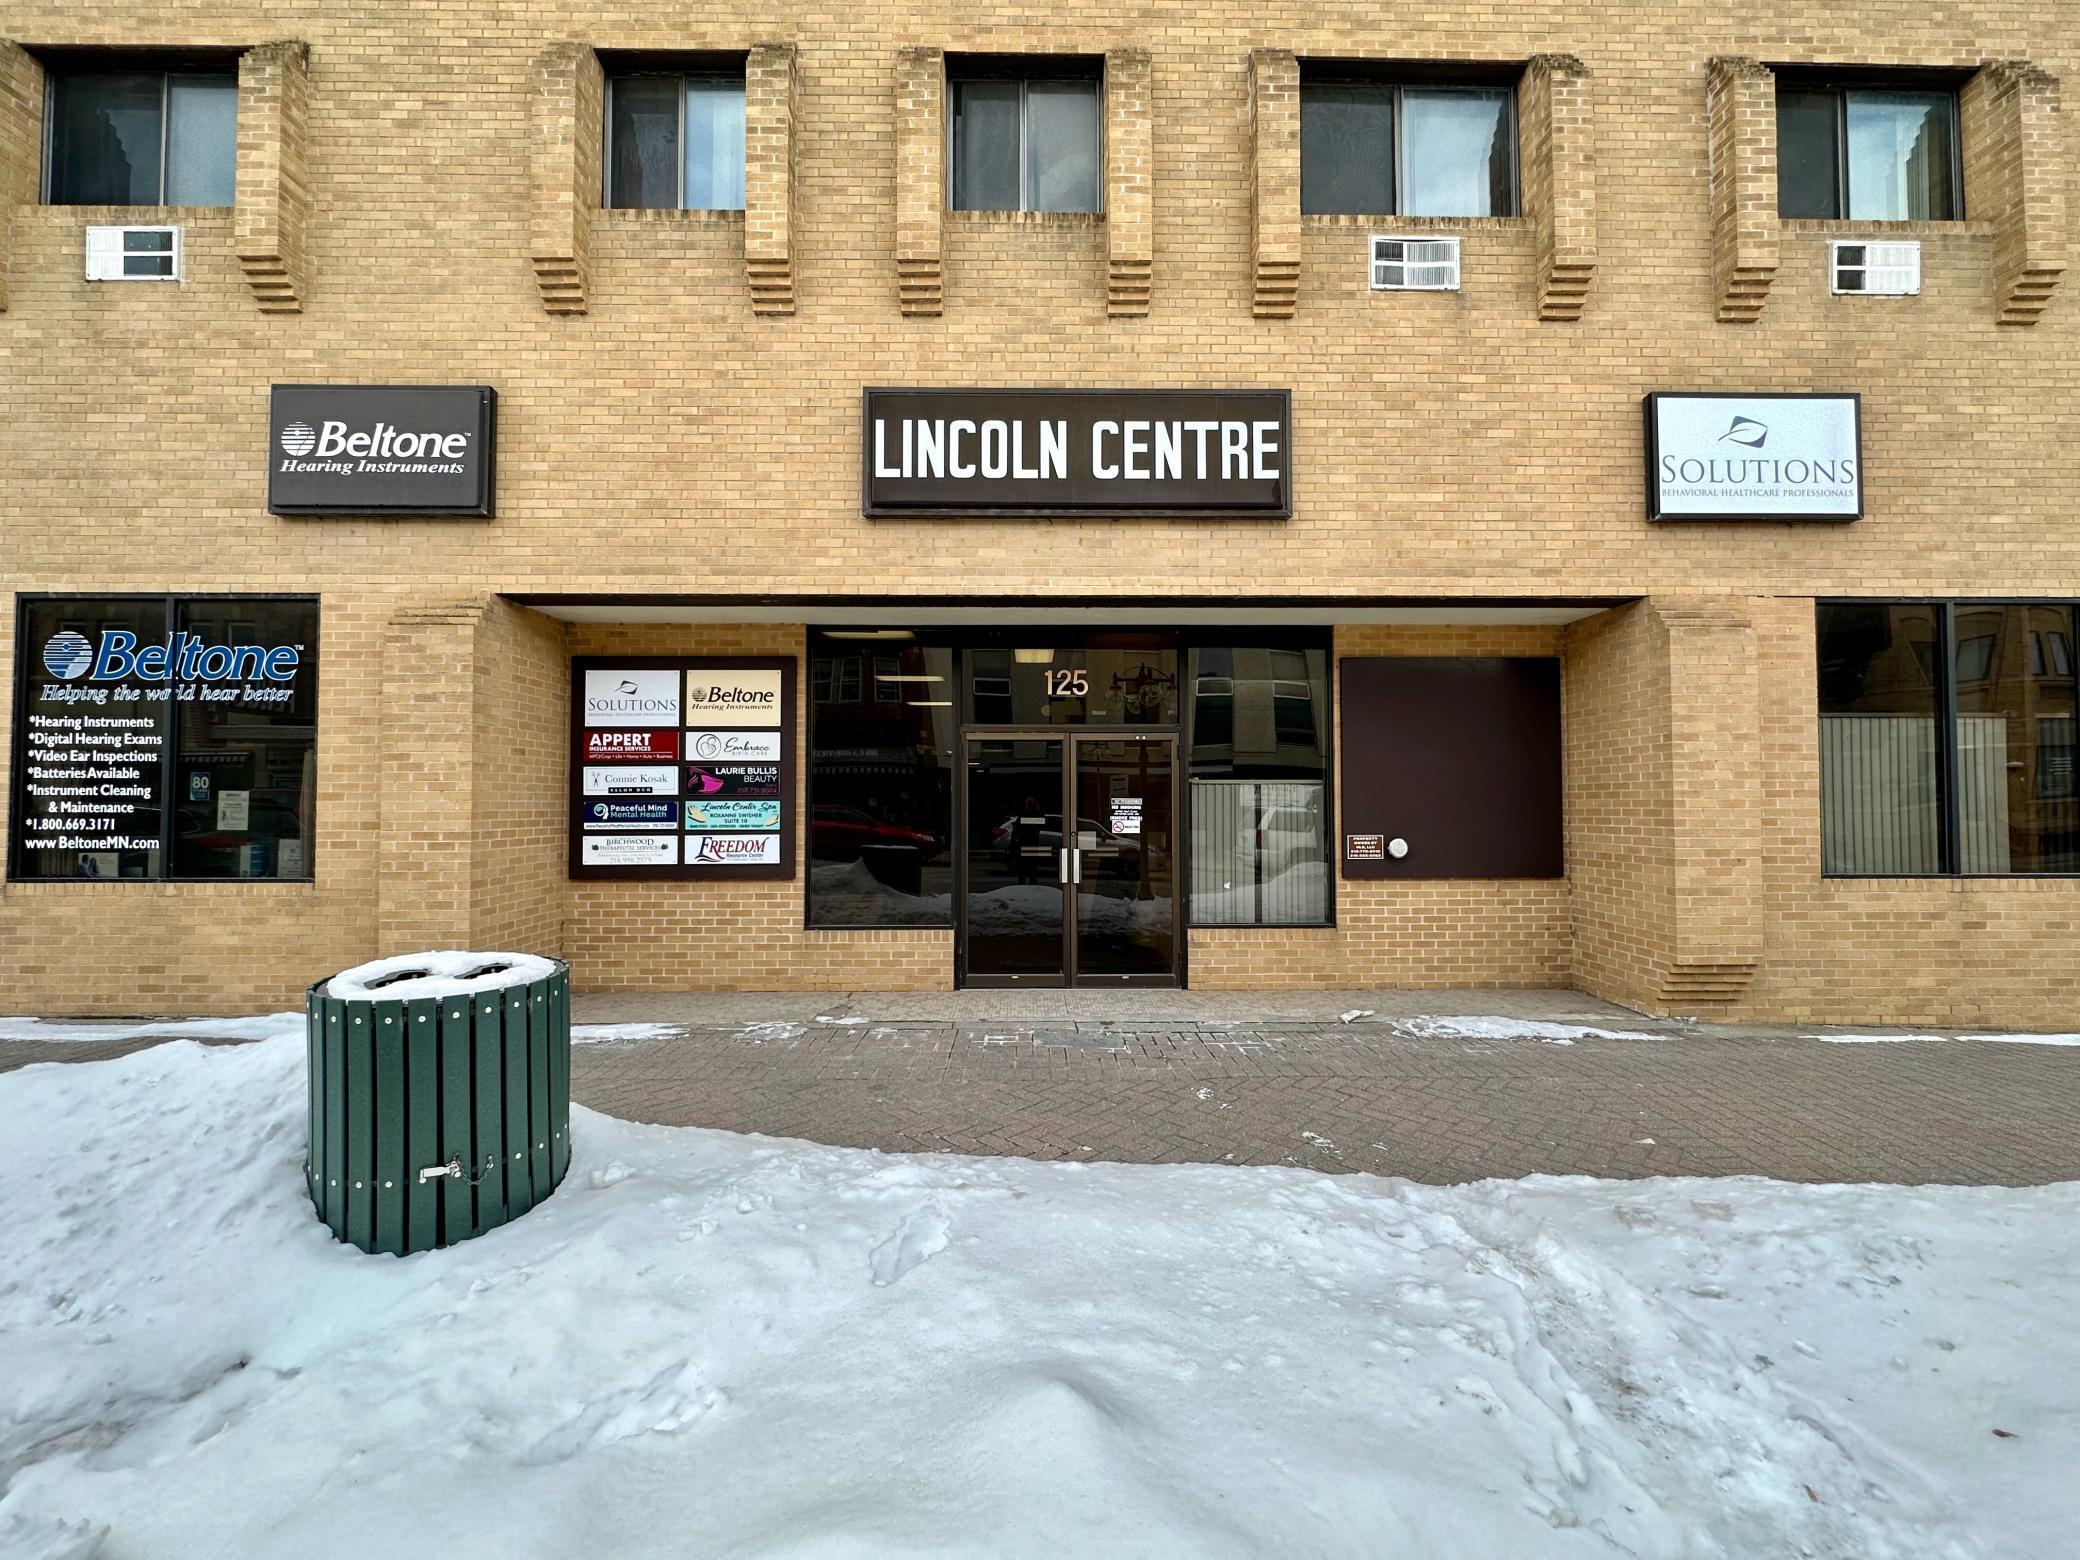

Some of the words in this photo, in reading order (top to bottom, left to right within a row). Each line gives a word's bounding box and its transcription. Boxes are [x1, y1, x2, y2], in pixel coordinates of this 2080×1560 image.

[874, 418, 1068, 479] LINCOLN
[1091, 420, 1280, 480] CENTRE
[280, 459, 354, 475] Hearing
[356, 459, 464, 474] Instruments
[1661, 455, 1854, 484] SOLUTIONS
[1662, 488, 1718, 497] BEHAVIORAL
[1721, 488, 1780, 497] HEALTHCARE
[1783, 489, 1854, 497] PROFESSIONALS
[1044, 669, 1089, 696] 125
[40, 683, 108, 705] Helping
[114, 684, 140, 701] the
[200, 684, 240, 701] hear
[243, 685, 294, 702] better
[588, 697, 677, 711] SOLUTIONS
[691, 703, 725, 711] Hearing
[726, 703, 773, 711] Instruments
[84, 715, 155, 728] Instruments
[75, 732, 122, 748] Hearing
[124, 732, 163, 745] Exams
[589, 733, 652, 746] APPERT
[70, 749, 91, 762] Ear
[92, 750, 158, 765] Inspections
[86, 766, 140, 779] Available
[715, 767, 746, 775] LAURIE
[747, 767, 778, 775] BULLIS
[192, 776, 209, 789] 80
[604, 774, 638, 783] Connie
[639, 774, 668, 783] Kosak
[743, 775, 778, 783] BEAUTY
[100, 784, 152, 799] Cleaning
[48, 801, 58, 813] &
[60, 801, 135, 813] Maintenance
[610, 804, 647, 812] Peaceful
[647, 804, 668, 812] Mind
[701, 802, 731, 812] Lincoln
[606, 838, 655, 846] BIRCHWOOD
[695, 837, 770, 859] FREEDOM
